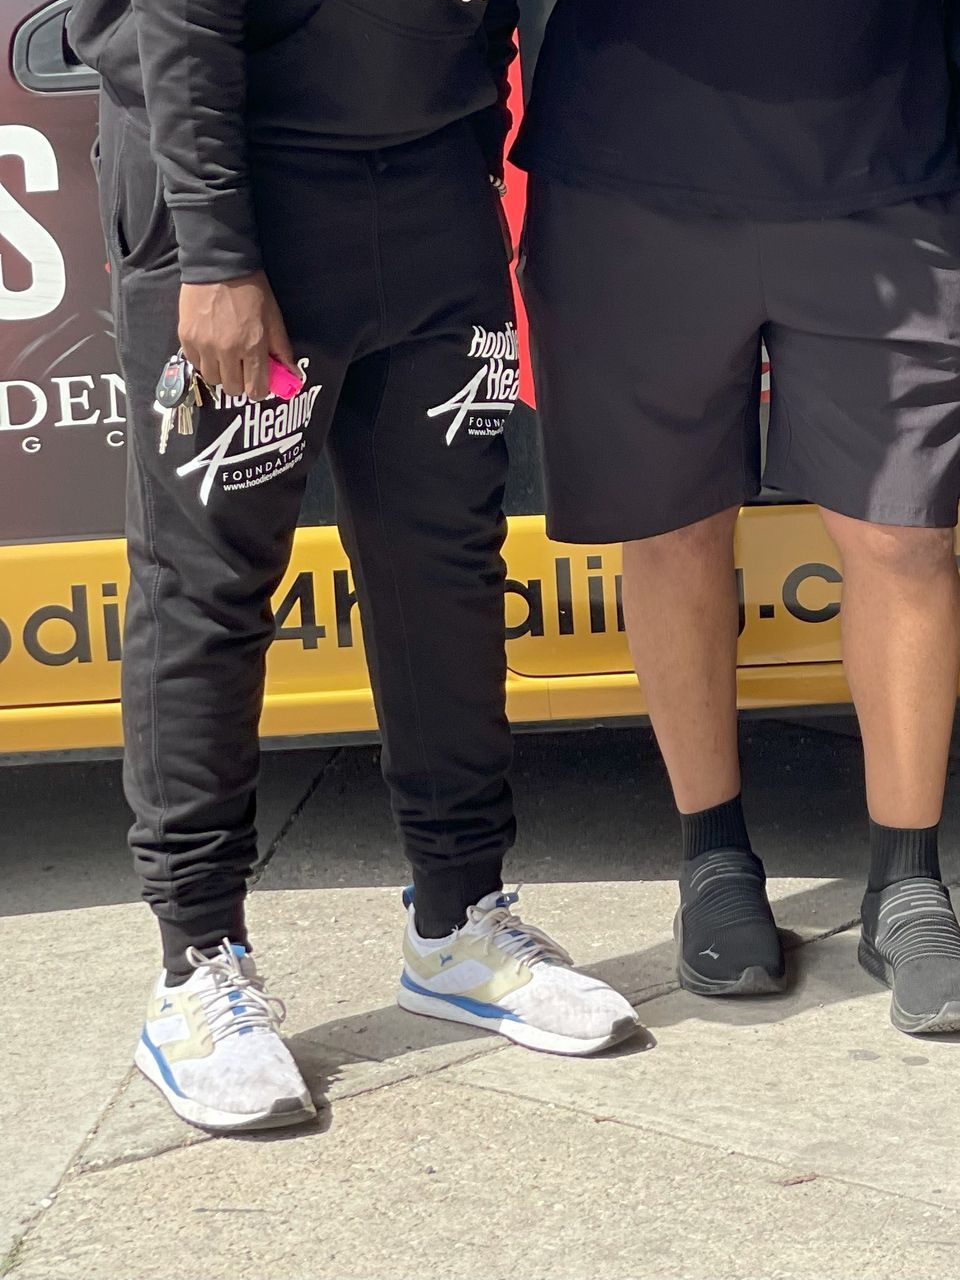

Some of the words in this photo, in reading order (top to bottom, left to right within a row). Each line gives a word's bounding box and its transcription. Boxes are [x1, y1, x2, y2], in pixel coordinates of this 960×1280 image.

[176, 414, 304, 506] 4
[243, 384, 322, 449] Healing
[223, 440, 306, 482] FOUNDATION
